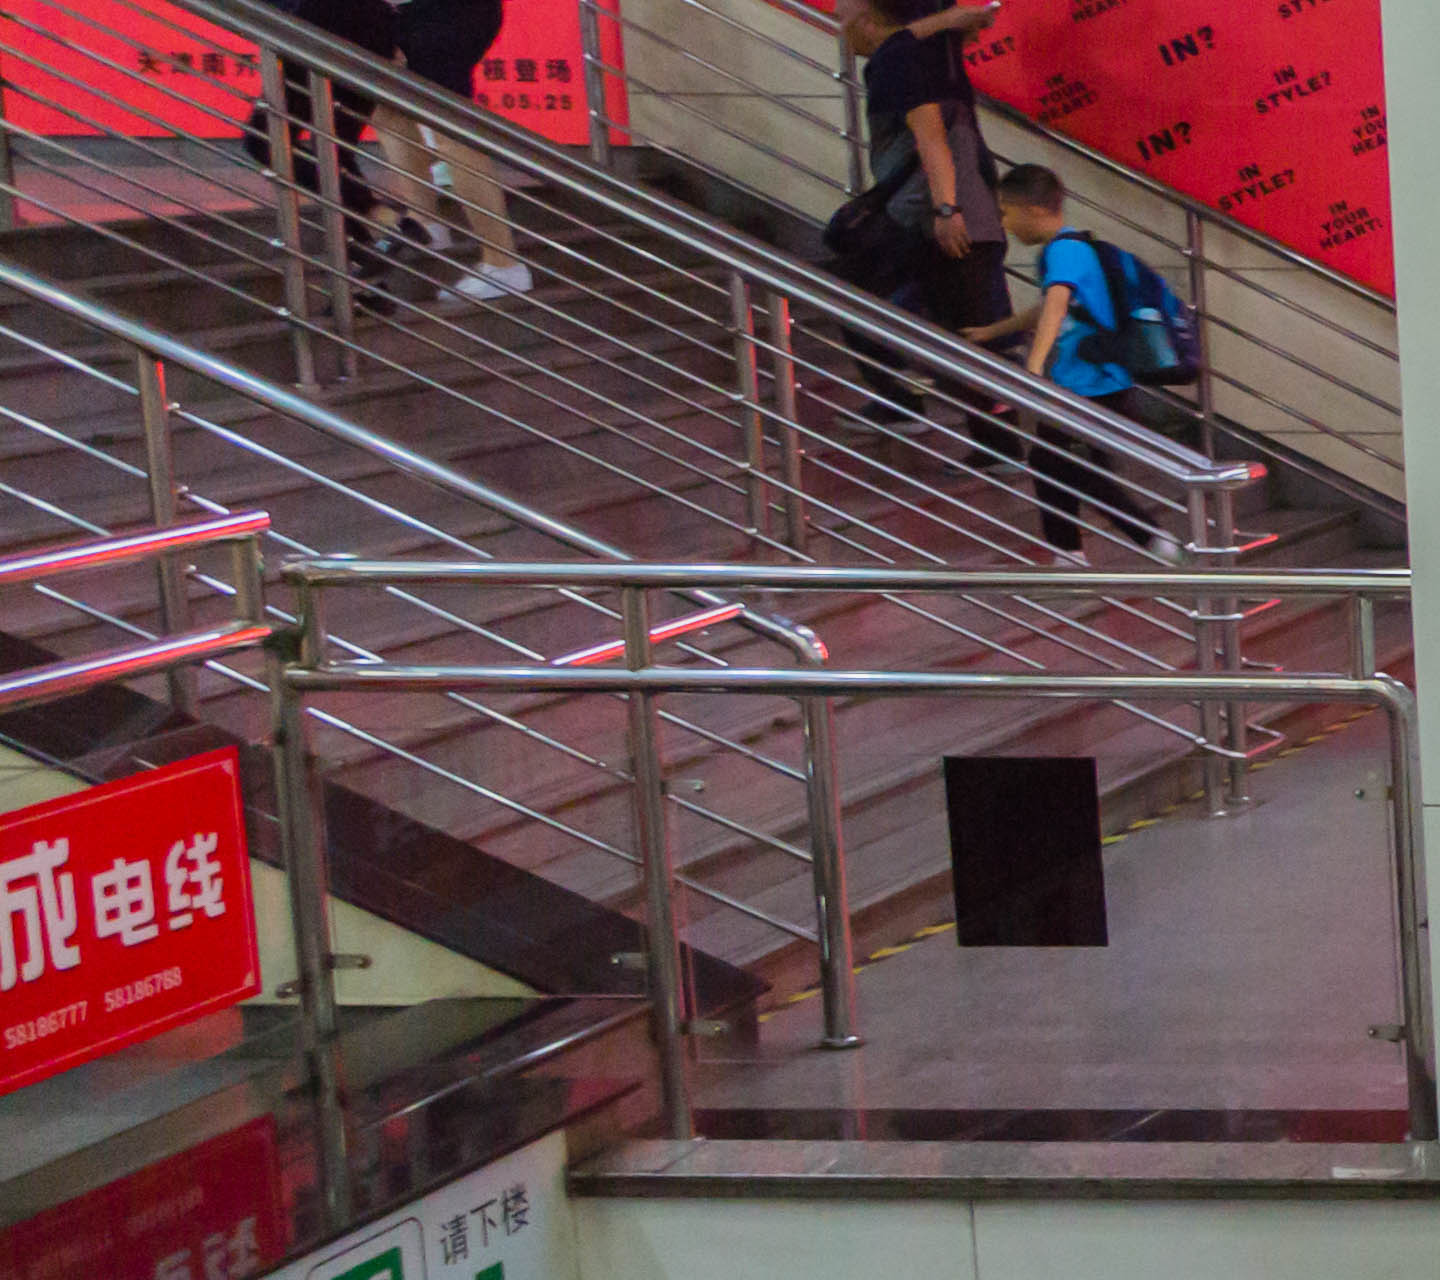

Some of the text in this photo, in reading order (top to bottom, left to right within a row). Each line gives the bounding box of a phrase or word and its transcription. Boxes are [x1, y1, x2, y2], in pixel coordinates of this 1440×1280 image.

[965, 36, 1015, 67] YLE?
[1158, 26, 1215, 66] IN?
[1274, 65, 1296, 85] IN
[1255, 72, 1331, 115] STYLE?
[1361, 105, 1379, 121] IN
[1137, 122, 1192, 161] IN?
[1353, 117, 1386, 139] YO
[1352, 134, 1386, 157] HEA
[1239, 164, 1261, 182] IN
[1219, 170, 1295, 212] STYLE?
[1321, 207, 1369, 233] YOUR
[1330, 200, 1348, 215] IN
[1320, 218, 1383, 251] HEART!
[440, 1184, 531, 1266] 请下楼
